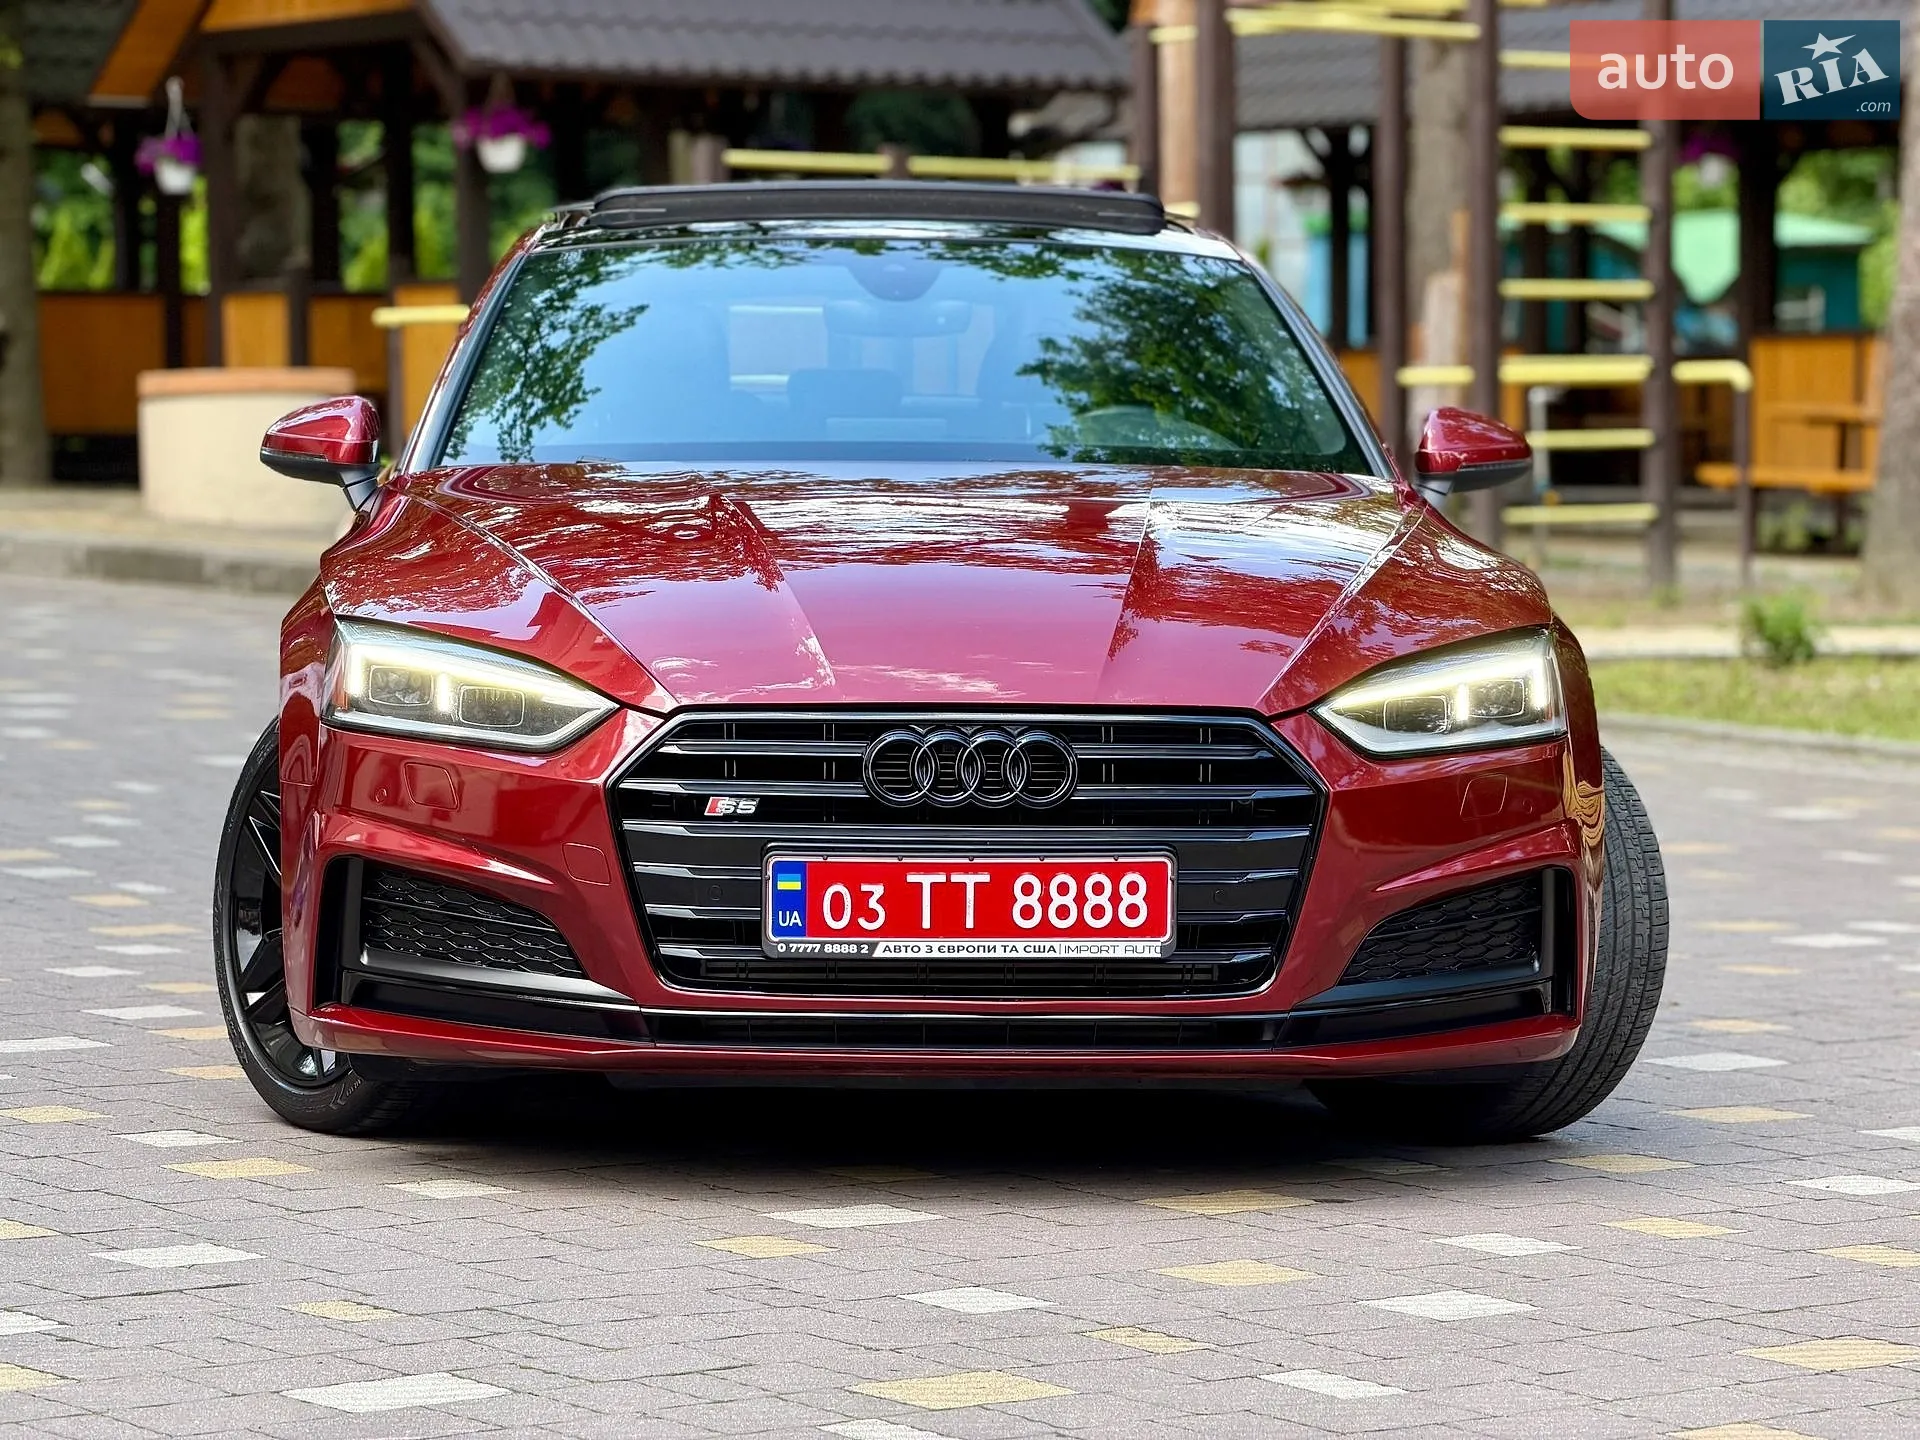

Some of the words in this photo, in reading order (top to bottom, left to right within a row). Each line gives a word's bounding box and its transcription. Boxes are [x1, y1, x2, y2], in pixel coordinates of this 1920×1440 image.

[822, 882, 886, 931] 03
[906, 871, 991, 930] TT
[1011, 872, 1149, 930] 8888
[778, 910, 803, 927] UA
[777, 943, 787, 953] 0
[789, 943, 822, 953] 7777
[823, 943, 858, 954] 8888
[859, 943, 869, 954] 2
[882, 944, 921, 954] АВТО
[938, 944, 997, 954] ЄВРОПИ
[1001, 944, 1020, 954] ТА
[1023, 944, 1057, 954] США
[1064, 944, 1119, 954] IMPORT
